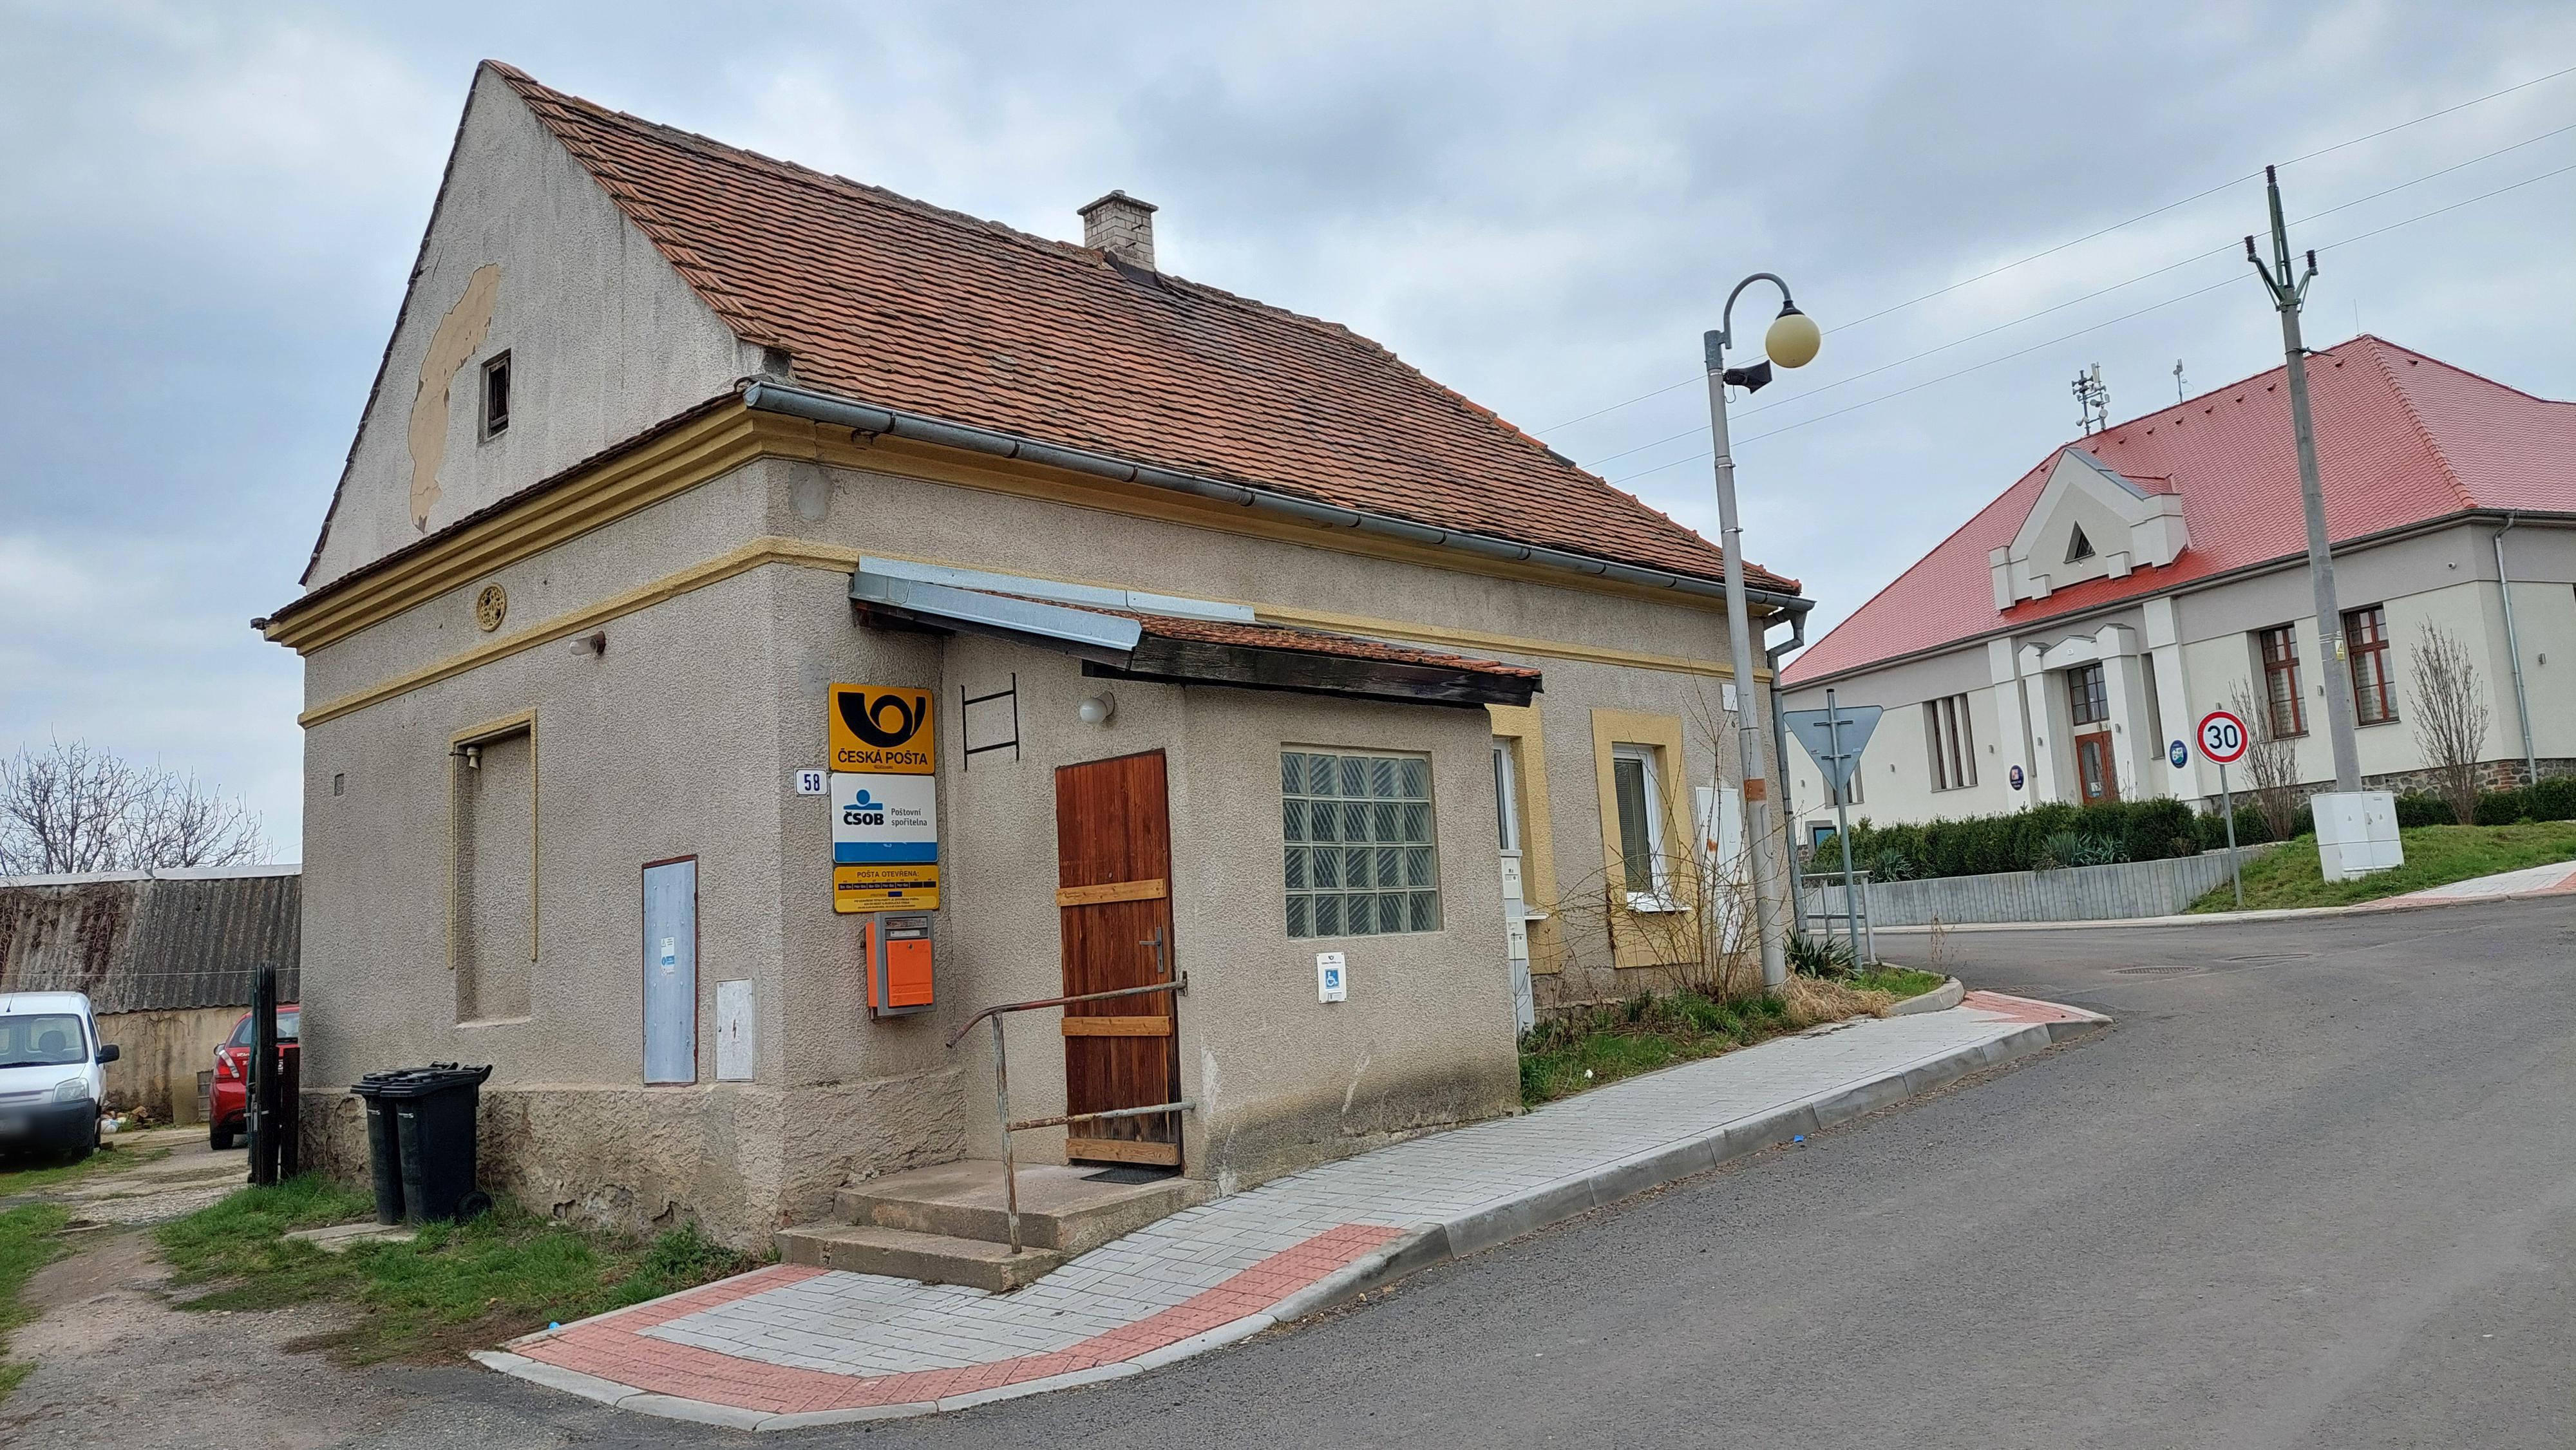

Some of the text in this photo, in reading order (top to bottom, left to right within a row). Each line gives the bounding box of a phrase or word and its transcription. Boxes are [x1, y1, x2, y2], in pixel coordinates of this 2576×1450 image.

[2207, 724, 2239, 749] 30
[837, 748, 928, 765] ČESKÁ POŠTA
[804, 773, 820, 791] 58
[843, 811, 884, 825] ČSOB
[891, 807, 922, 816] Poštovní
[891, 818, 927, 827] spořitelna
[857, 869, 920, 878] POŠTA OTEVŘENA:
